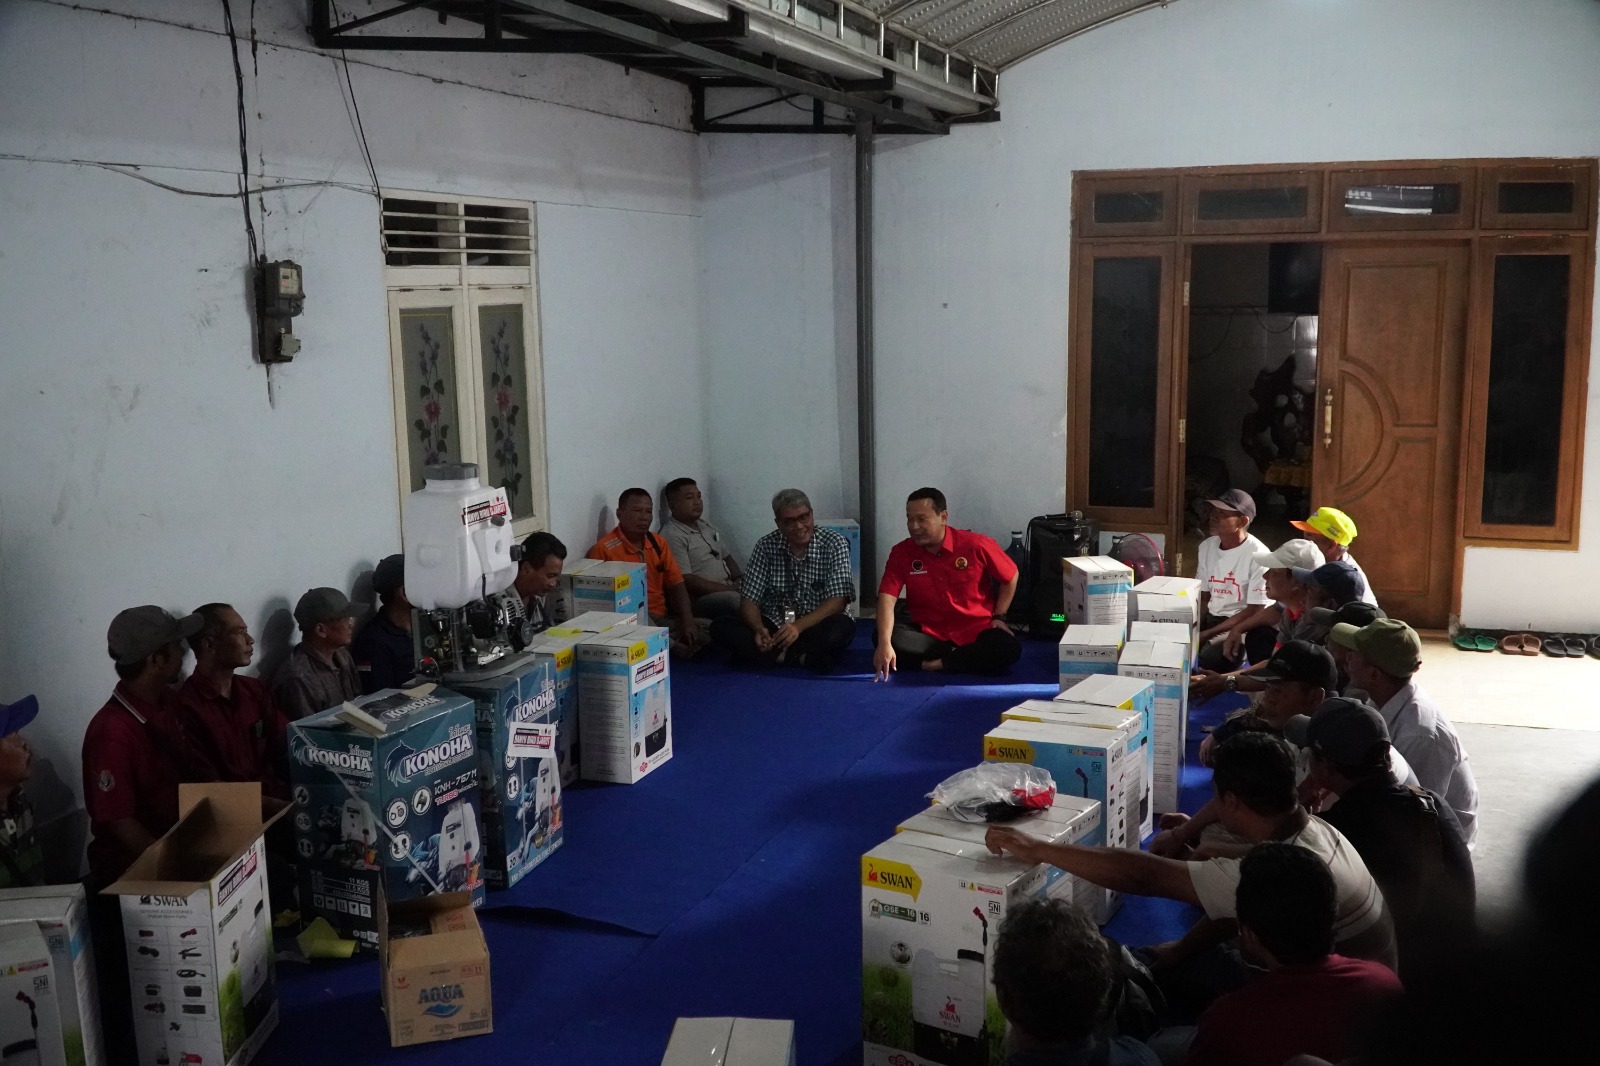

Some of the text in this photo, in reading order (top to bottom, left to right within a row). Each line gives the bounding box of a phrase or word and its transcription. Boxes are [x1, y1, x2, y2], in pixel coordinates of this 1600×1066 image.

[515, 689, 555, 722] KONOHA
[308, 748, 371, 771] KONOHA
[405, 734, 471, 776] KONOHA
[998, 746, 1027, 760] SWAN
[434, 788, 459, 806] TURBO
[880, 872, 913, 889] SWAN
[154, 895, 188, 906] SWAN
[988, 902, 1001, 914] SNI
[919, 911, 930, 922] 16
[49, 936, 64, 947] SNI
[33, 977, 48, 989] SNI
[417, 984, 465, 1004] AQUA
[939, 1011, 961, 1023] SWAN
